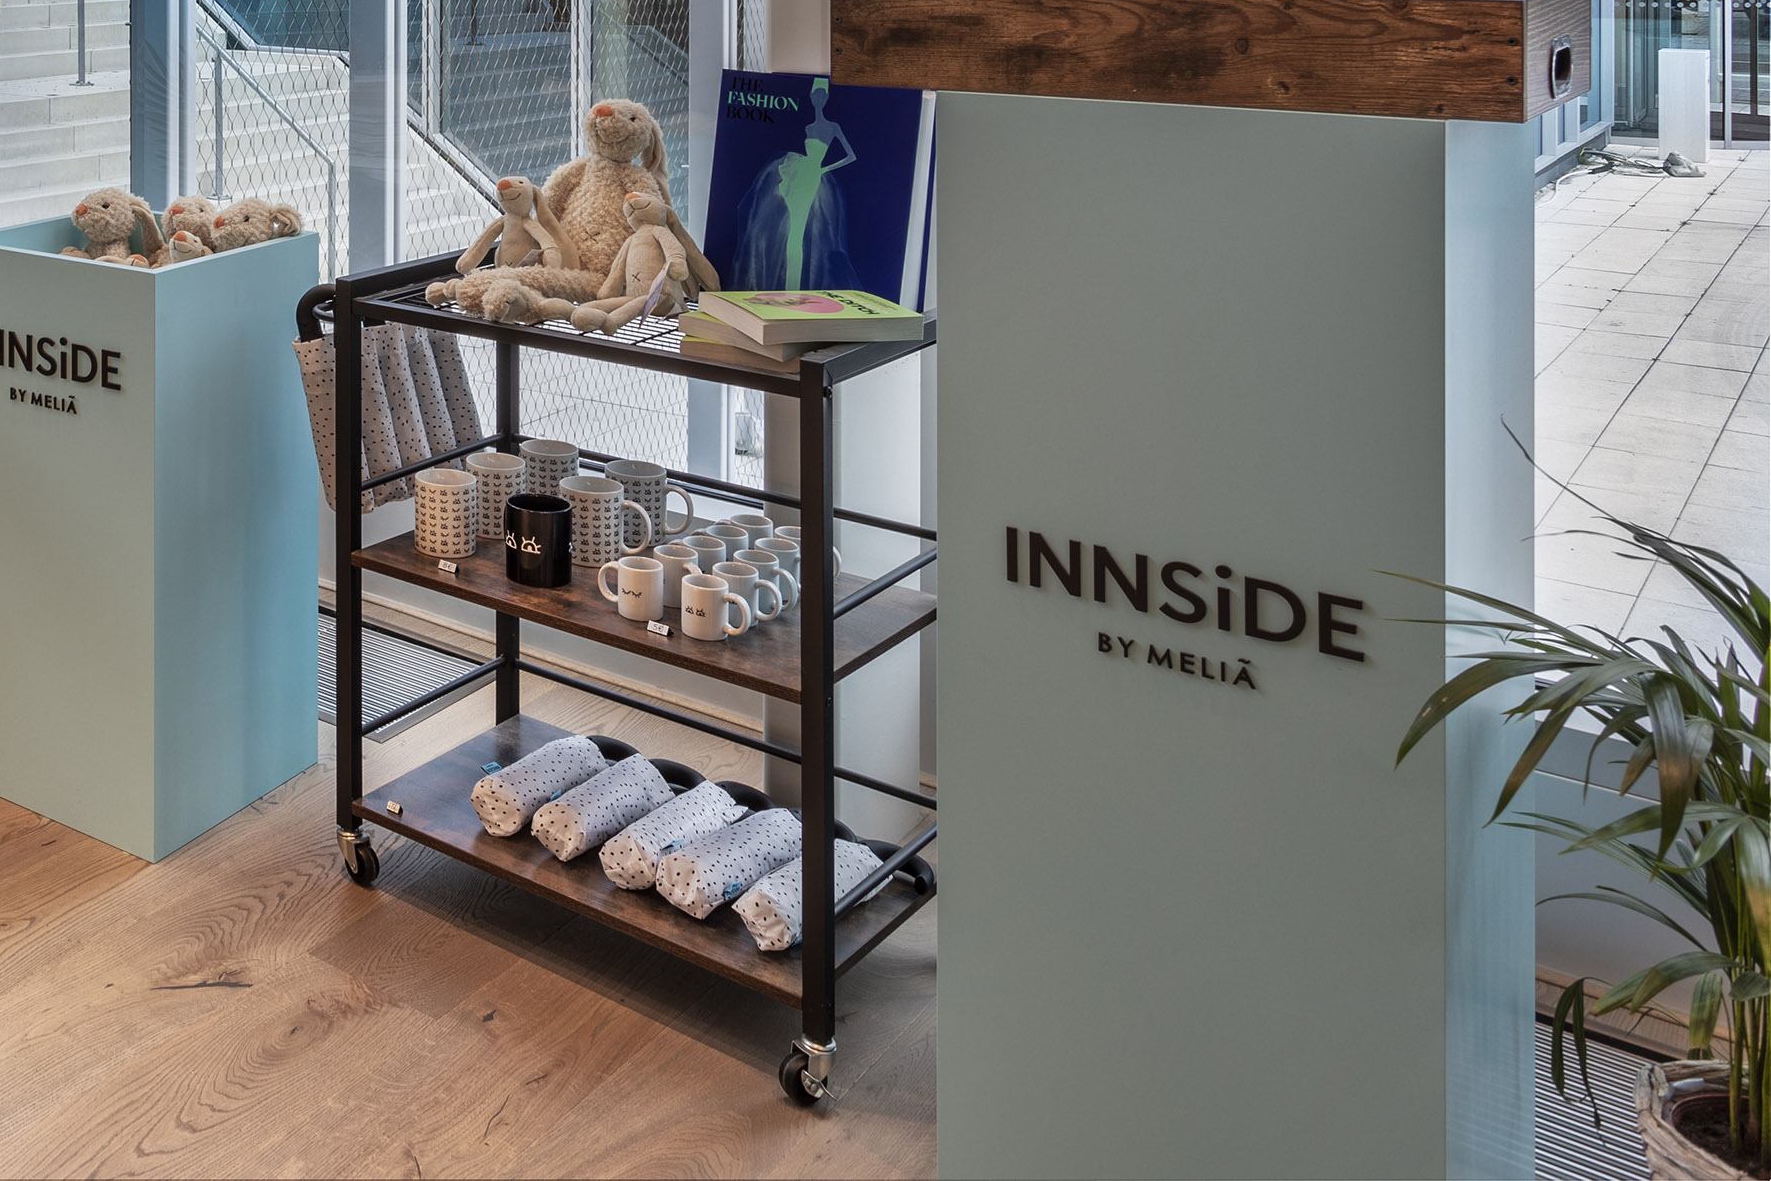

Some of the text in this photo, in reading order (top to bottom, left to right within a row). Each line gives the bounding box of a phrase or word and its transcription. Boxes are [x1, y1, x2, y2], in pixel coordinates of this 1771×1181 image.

[732, 75, 764, 92] THE
[728, 91, 800, 111] FASHION
[726, 105, 775, 123] BOOK
[10, 387, 27, 402] BY
[1006, 526, 1364, 662] INNSiDE
[1097, 632, 1134, 658] BY
